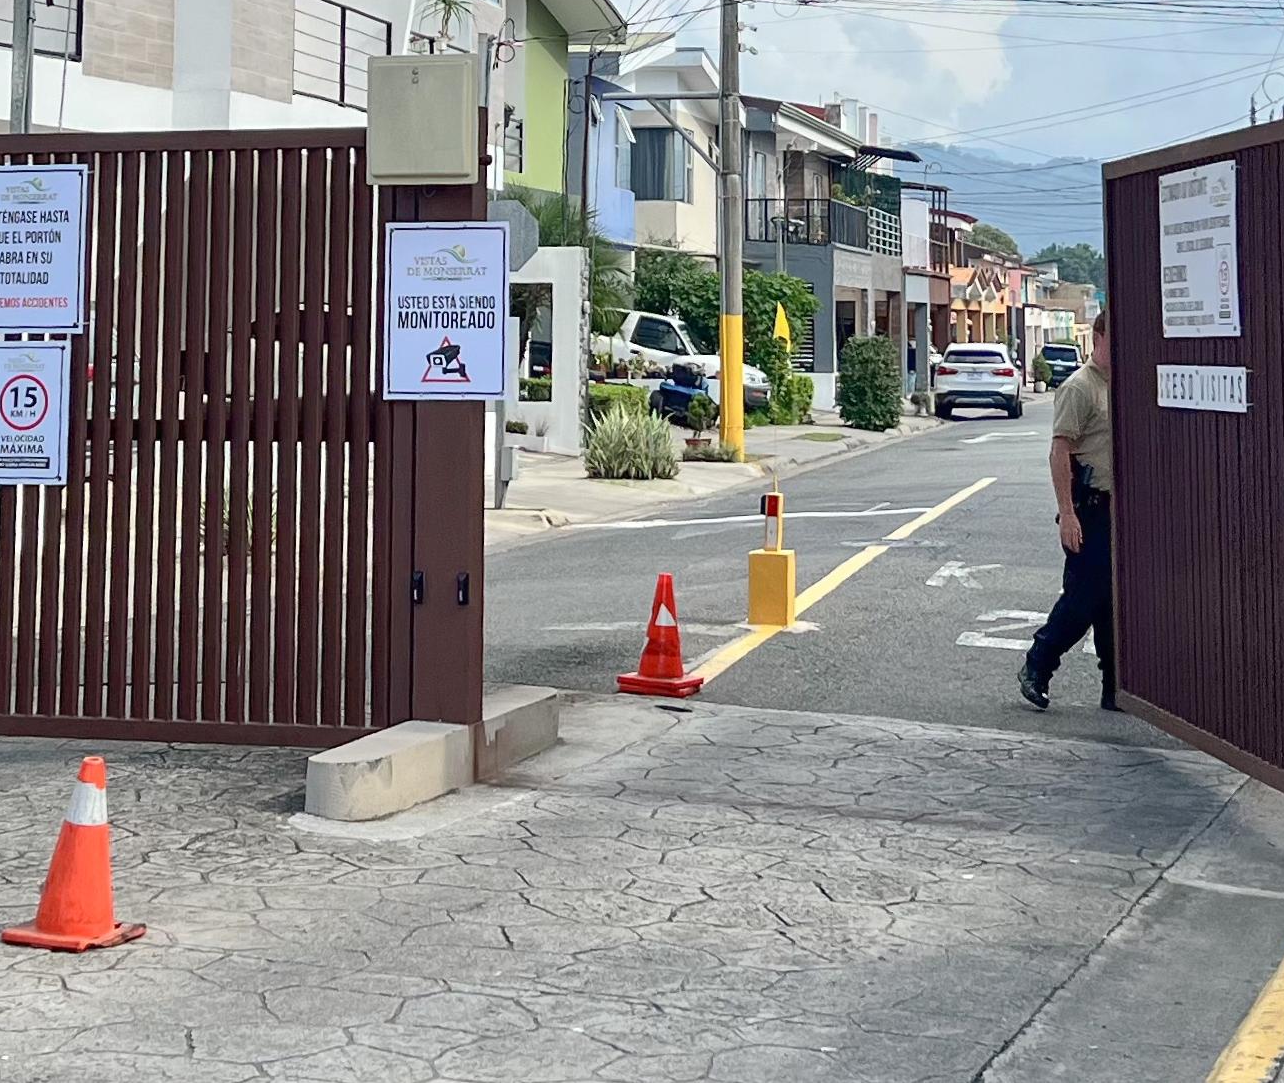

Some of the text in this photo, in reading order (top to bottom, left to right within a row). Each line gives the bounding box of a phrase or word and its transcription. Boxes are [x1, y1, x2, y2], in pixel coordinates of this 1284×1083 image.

[39, 209, 70, 224] HASTA
[12, 231, 23, 244] EL
[25, 228, 62, 244] PORTÓN
[26, 251, 38, 264] EN
[40, 251, 53, 264] SU
[0, 271, 49, 285] TOTALIDAD
[22, 297, 68, 308] ACCIDENTES
[397, 292, 496, 310] USTED ESTÁ SIENDO
[397, 311, 496, 330] MONITOREADO
[1200, 374, 1242, 404] VISITAS
[10, 386, 38, 409] 15
[0, 435, 45, 443] VELOCIDAD
[0, 443, 44, 454] MÁXIMA
